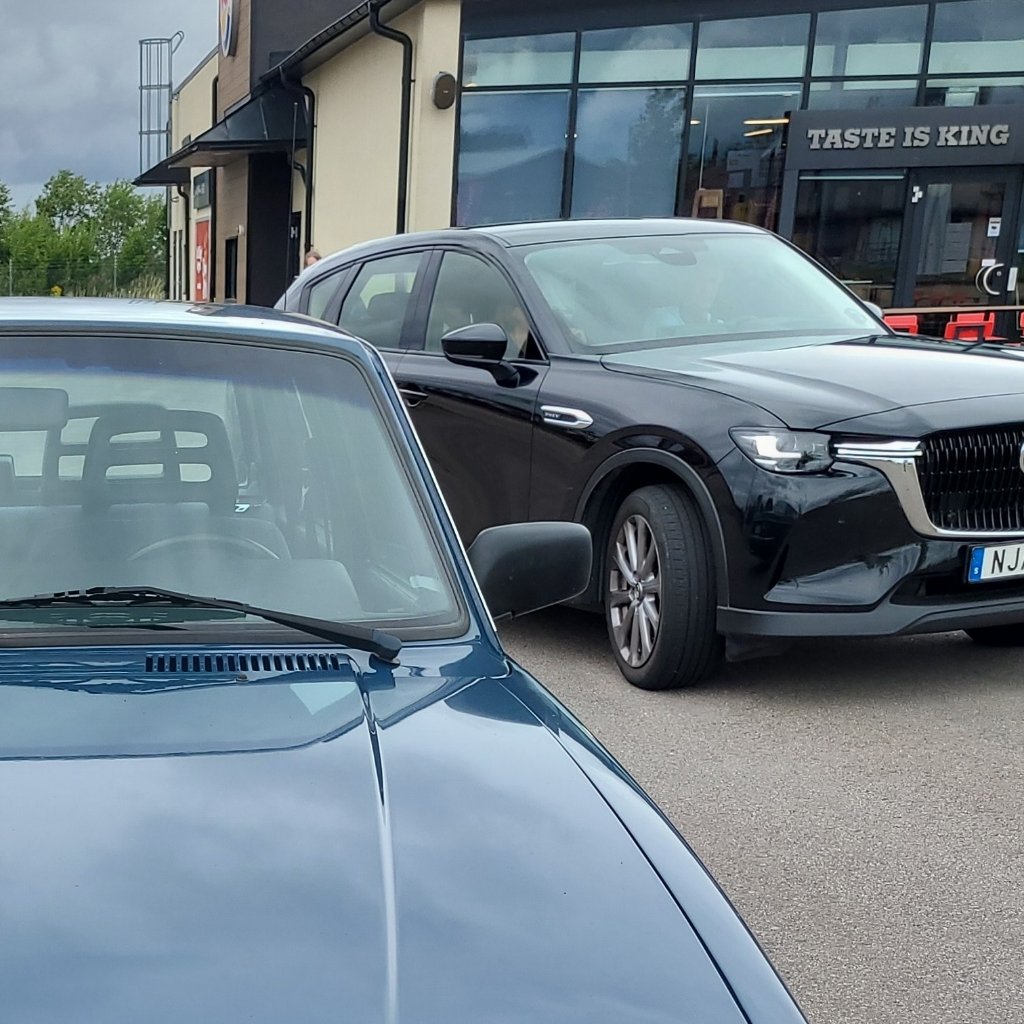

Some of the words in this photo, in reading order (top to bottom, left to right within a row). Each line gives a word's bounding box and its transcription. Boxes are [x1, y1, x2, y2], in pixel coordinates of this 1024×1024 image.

[807, 127, 896, 149] TASTE
[902, 126, 930, 147] IS
[937, 124, 1010, 147] KING
[991, 547, 1024, 574] NJ
